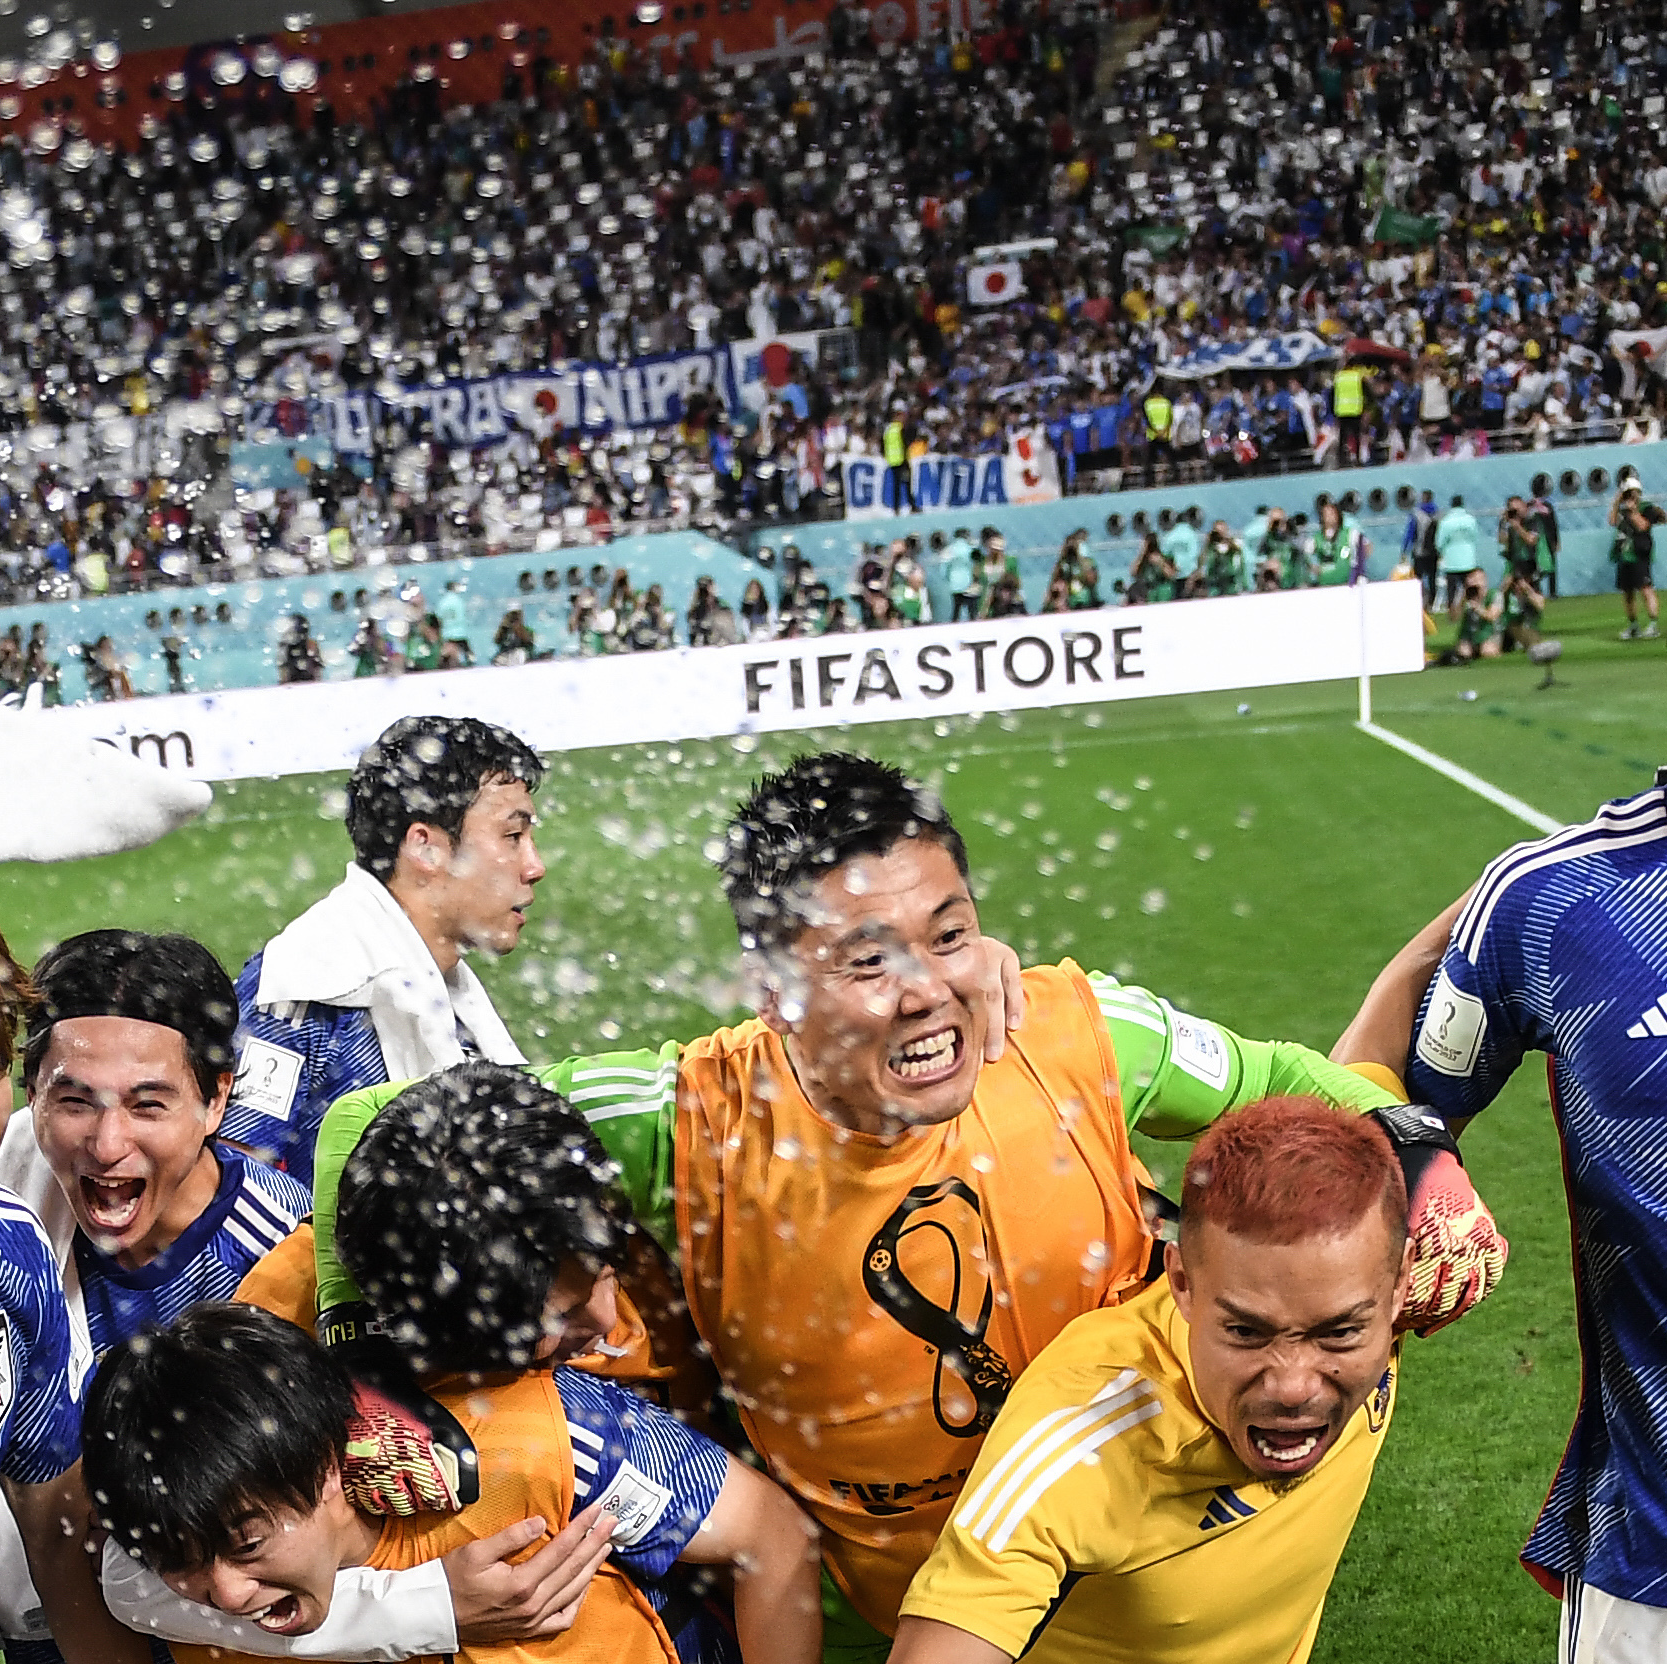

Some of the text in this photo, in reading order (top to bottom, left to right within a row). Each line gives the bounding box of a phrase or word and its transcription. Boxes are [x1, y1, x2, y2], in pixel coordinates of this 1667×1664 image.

[744, 625, 1145, 713] FIFA STORE
[325, 1320, 357, 1347] EIJI
